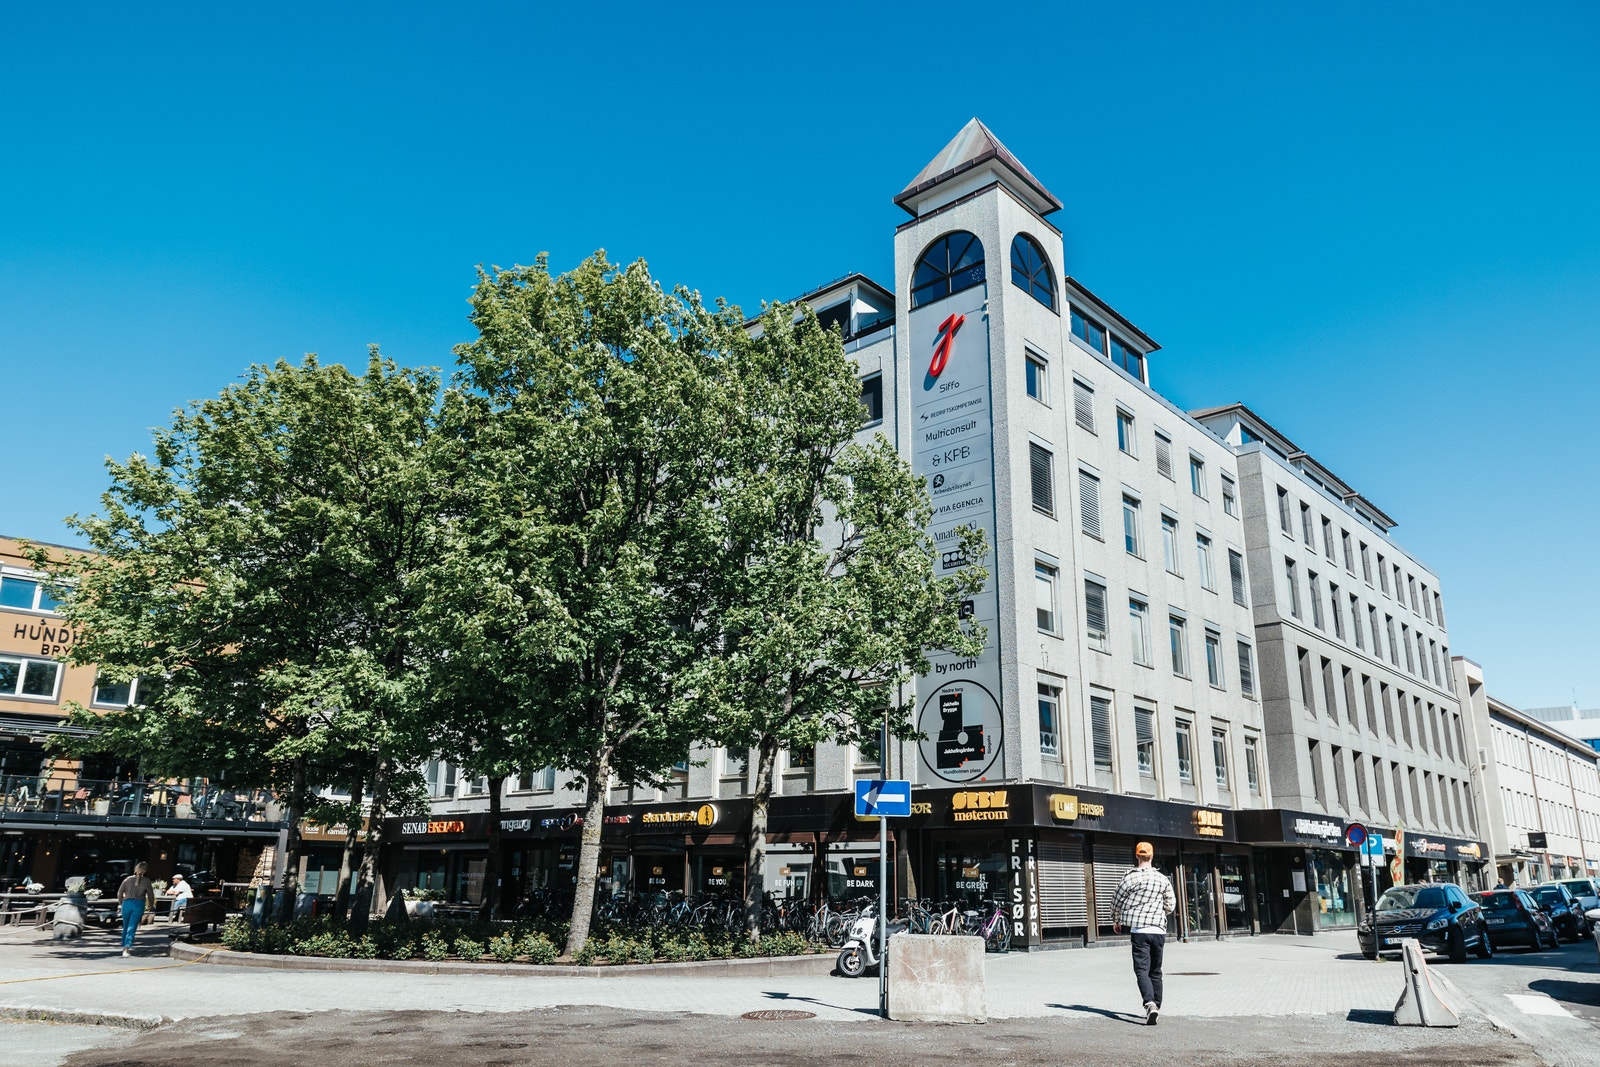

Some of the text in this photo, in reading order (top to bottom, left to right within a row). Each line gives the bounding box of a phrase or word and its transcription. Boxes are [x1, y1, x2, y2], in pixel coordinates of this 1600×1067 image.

[940, 380, 960, 393] Siffo
[926, 420, 977, 442] Multiconsult
[944, 446, 970, 464] KPB
[933, 481, 972, 495] Arbeidstilsynet
[939, 505, 951, 513] VIA
[952, 497, 984, 510] EGENCIA
[935, 659, 977, 675] by north
[953, 810, 1009, 822] møterom
[1058, 801, 1105, 817] LIME FRISØR
[402, 822, 427, 834] SENAB
[1011, 839, 1024, 936] FRISØR
[1027, 839, 1039, 936] FRISØR
